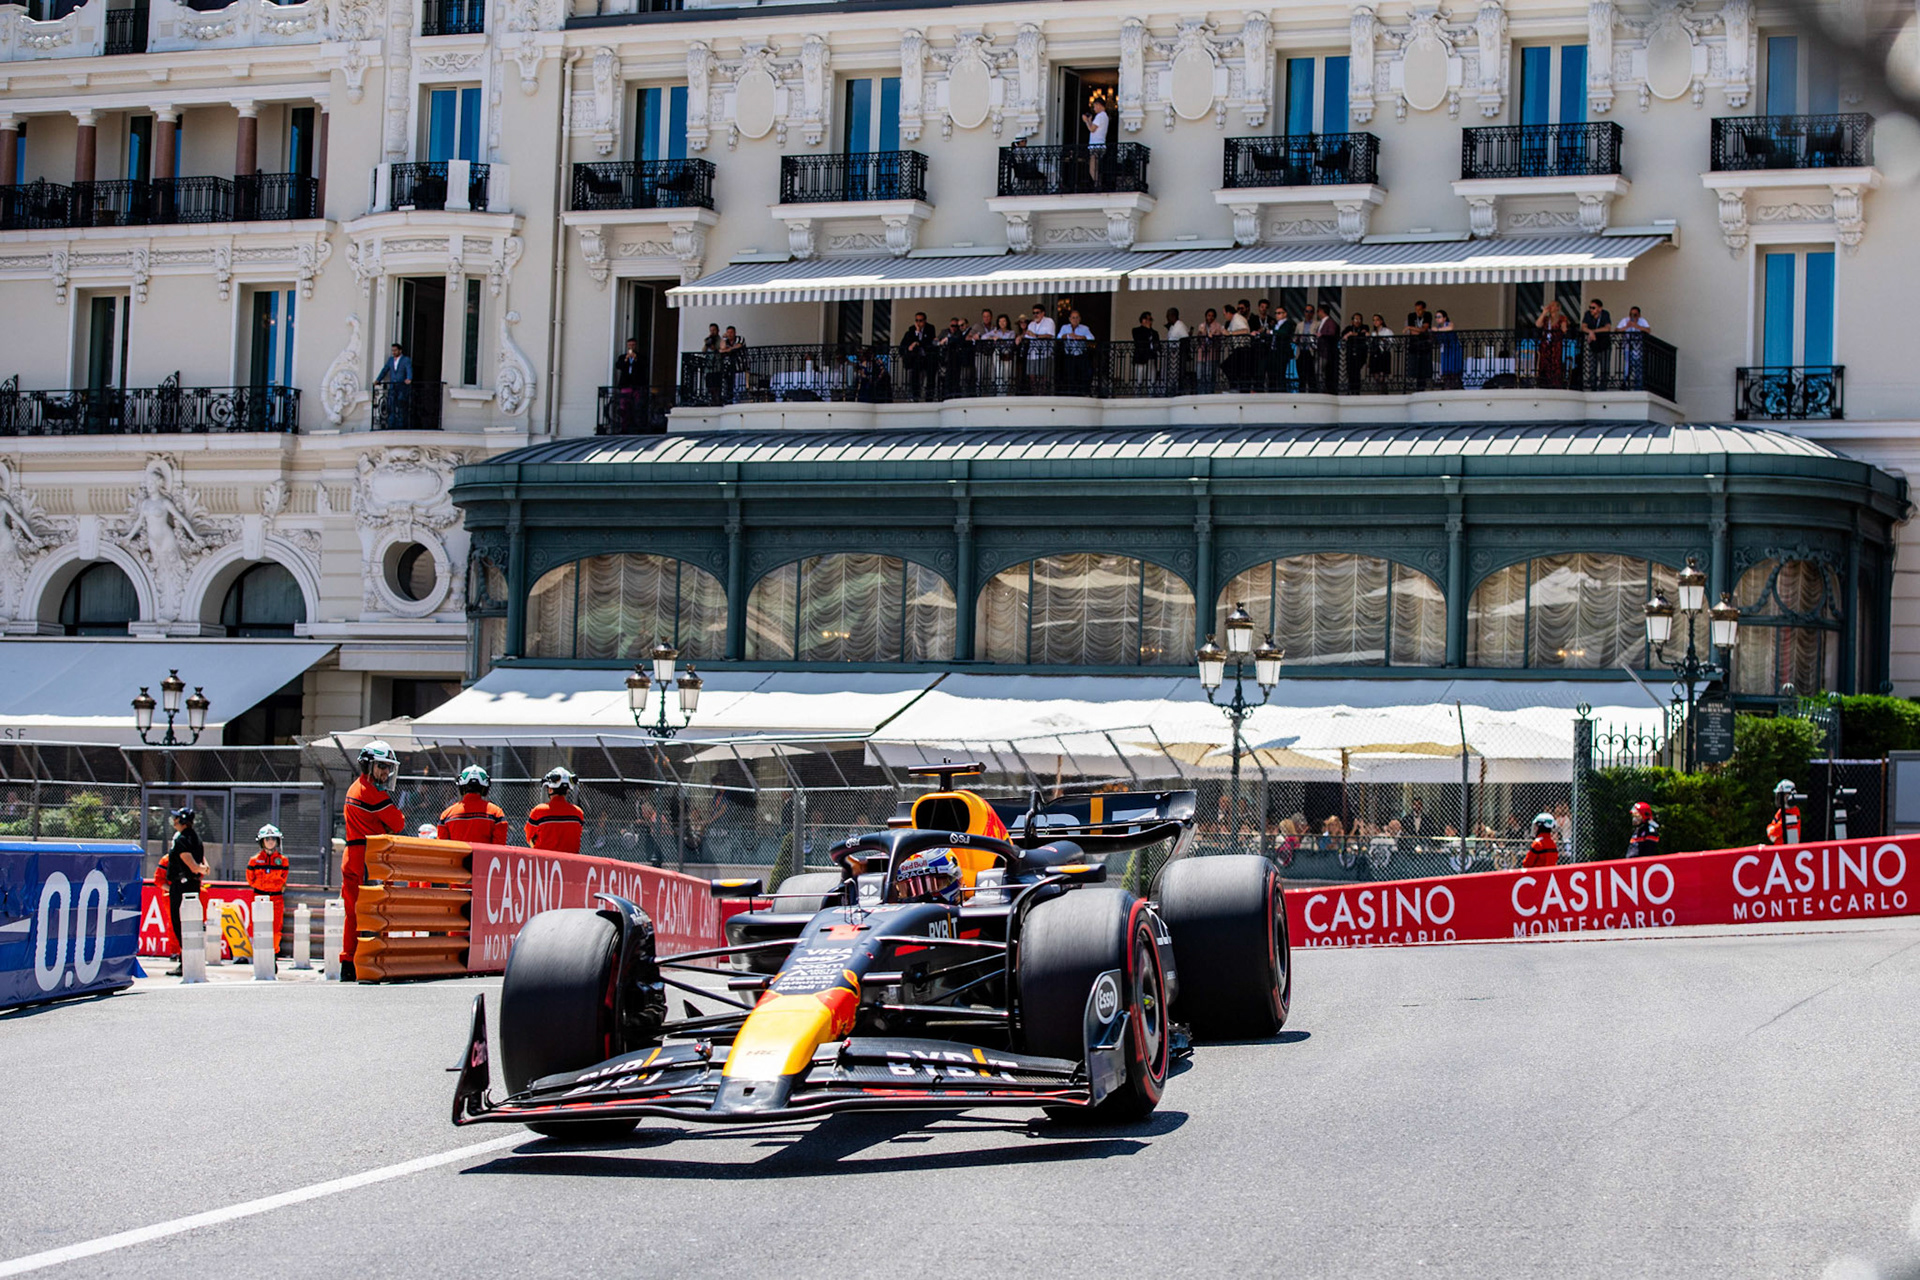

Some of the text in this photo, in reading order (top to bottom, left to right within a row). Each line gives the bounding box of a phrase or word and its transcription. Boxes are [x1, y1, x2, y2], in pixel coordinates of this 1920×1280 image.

[486, 856, 563, 925] CASINO
[897, 867, 937, 882] ORACLE
[1512, 863, 1675, 917] CASINO
[1732, 843, 1907, 897] CASINO
[656, 878, 693, 936] CASINO
[1304, 885, 1455, 933] CASINO
[1513, 908, 1676, 939] MONTE CARLO
[1733, 890, 1908, 920] MONTE CARLO
[35, 868, 109, 991] 0.0
[221, 914, 251, 955] FCY
[483, 934, 517, 961] MONT
[805, 948, 854, 956] VISA
